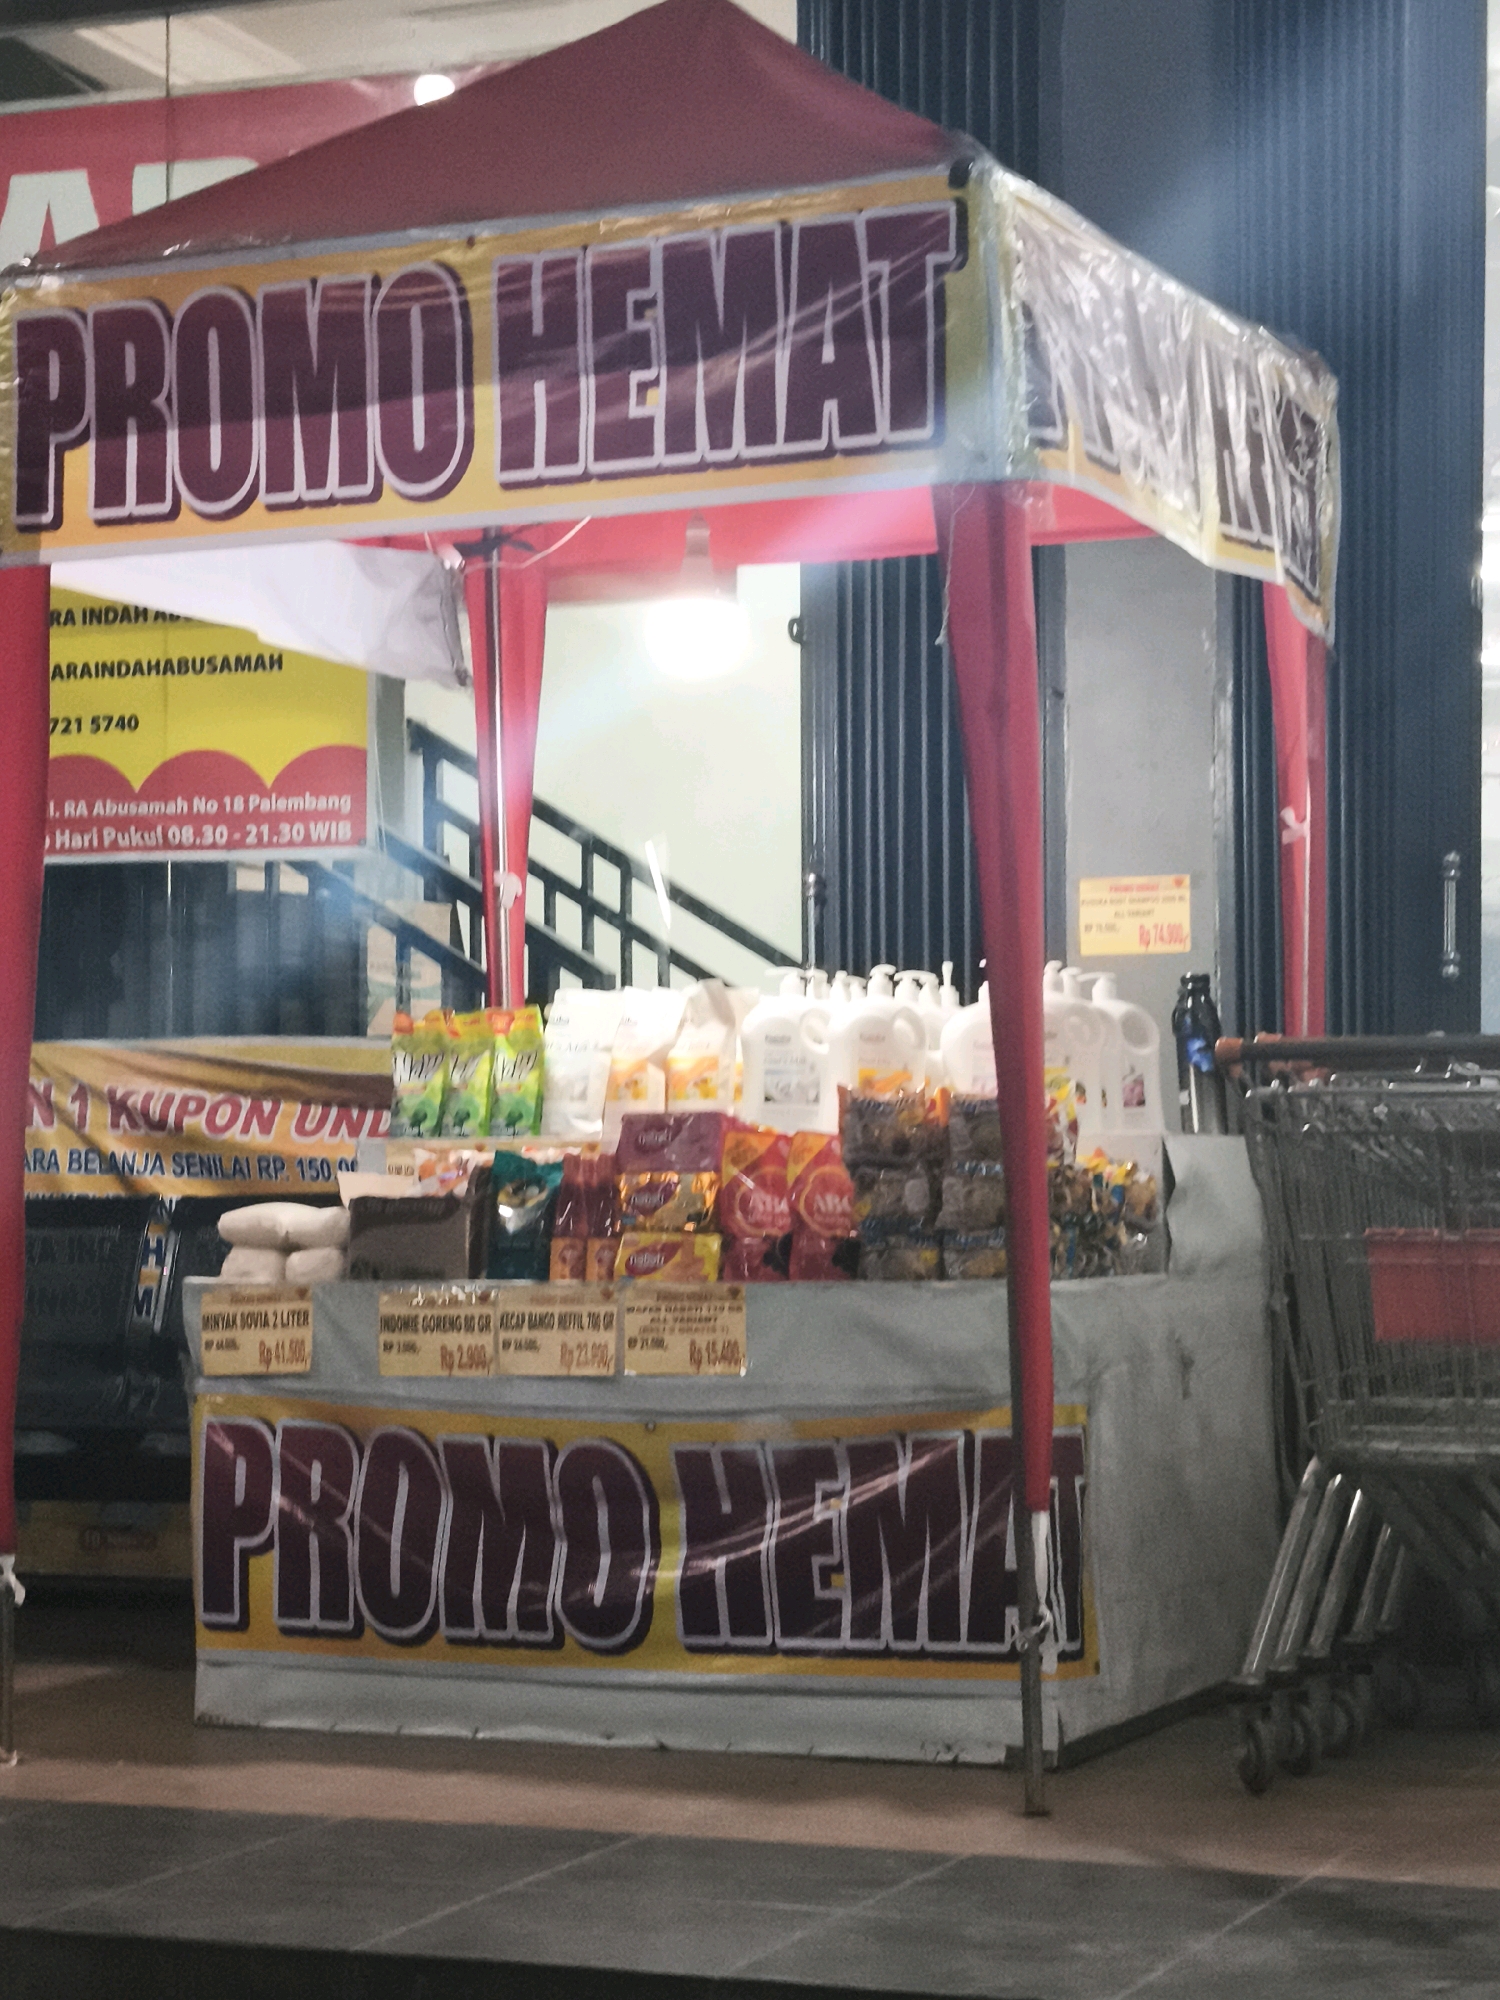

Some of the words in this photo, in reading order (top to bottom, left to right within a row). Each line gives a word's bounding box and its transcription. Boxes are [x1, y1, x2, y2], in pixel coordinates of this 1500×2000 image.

[12, 259, 476, 534] PROMO
[491, 197, 968, 490] HEMAT
[82, 605, 149, 626] INDAH
[90, 714, 139, 734] 5740
[64, 799, 88, 818] RA
[93, 795, 188, 818] Abusamah
[193, 796, 218, 814] No
[248, 791, 351, 814] Palembang
[55, 825, 98, 849] Hari
[103, 824, 163, 849] Pukul
[246, 822, 304, 845] 21.30
[309, 820, 351, 844] WIB
[69, 1080, 90, 1132] 1
[105, 1084, 283, 1141] KUPON
[68, 1148, 166, 1178] BELANJA
[171, 1151, 251, 1181] SENILAI
[202, 1311, 237, 1332] MINYAK
[273, 1311, 278, 1329] 2
[280, 1309, 309, 1329] LITER
[422, 1313, 462, 1333] GORENG
[478, 1314, 492, 1333] GR
[499, 1311, 526, 1331] KECAP
[603, 1311, 615, 1331] GR
[258, 1339, 272, 1372] Rp
[440, 1343, 455, 1376] Rp
[560, 1341, 574, 1374] Rp
[202, 1416, 662, 1656] PROMO
[673, 1426, 1088, 1662] HEMAT
